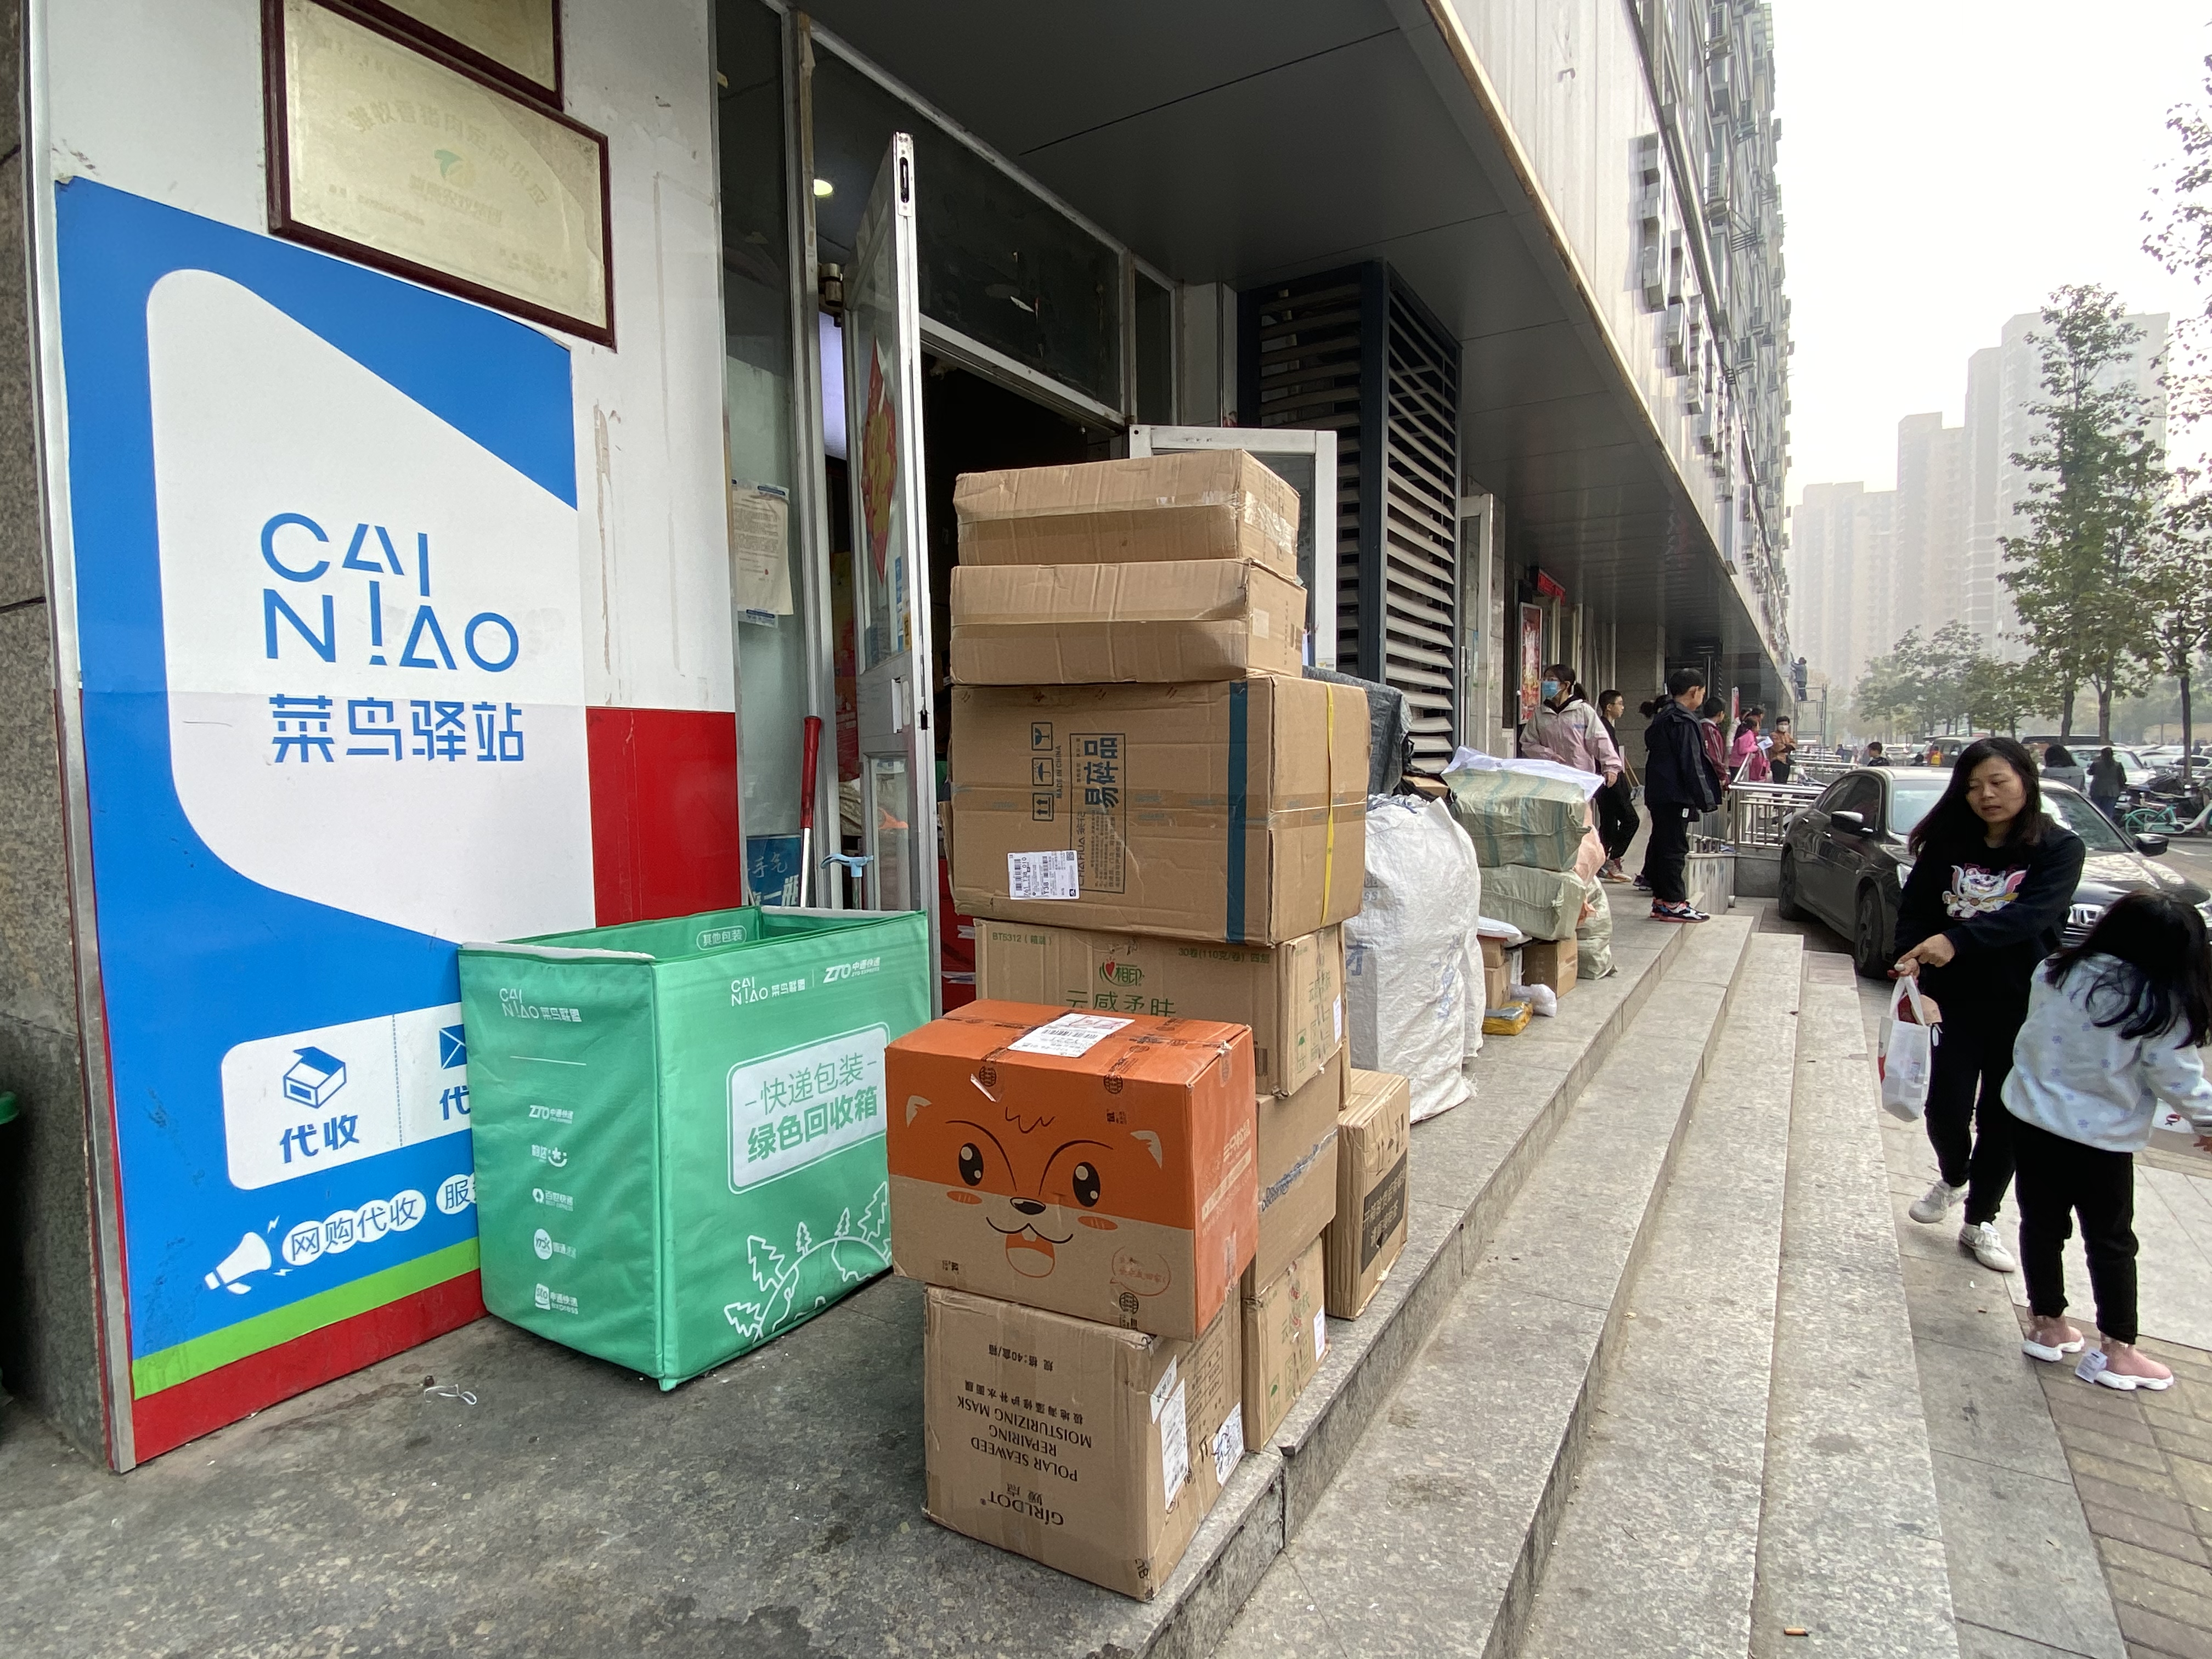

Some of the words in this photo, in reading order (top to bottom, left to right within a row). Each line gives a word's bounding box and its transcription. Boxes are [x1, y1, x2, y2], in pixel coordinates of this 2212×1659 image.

[261, 512, 431, 597] CAI
[269, 693, 524, 763] 菜鸟驿站
[1084, 737, 1119, 808] 易碎品
[703, 930, 742, 946] 其他包装
[731, 976, 755, 993] CAI
[823, 963, 851, 984] ZTO
[852, 957, 881, 971] 中通快递
[499, 988, 522, 1003] CAI
[529, 1104, 550, 1120] ZTO
[748, 1086, 878, 1163] 绿色回收箱
[280, 1115, 359, 1163] 代收
[445, 1178, 476, 1210] 服
[291, 1197, 417, 1261] 网购代收
[957, 1395, 990, 1418] MASK
[989, 1424, 1057, 1457] REPAIRING
[994, 1408, 1092, 1448] MOISTURIZING
[970, 1436, 1029, 1466] SEAWEED
[1034, 1457, 1077, 1482] POLAR
